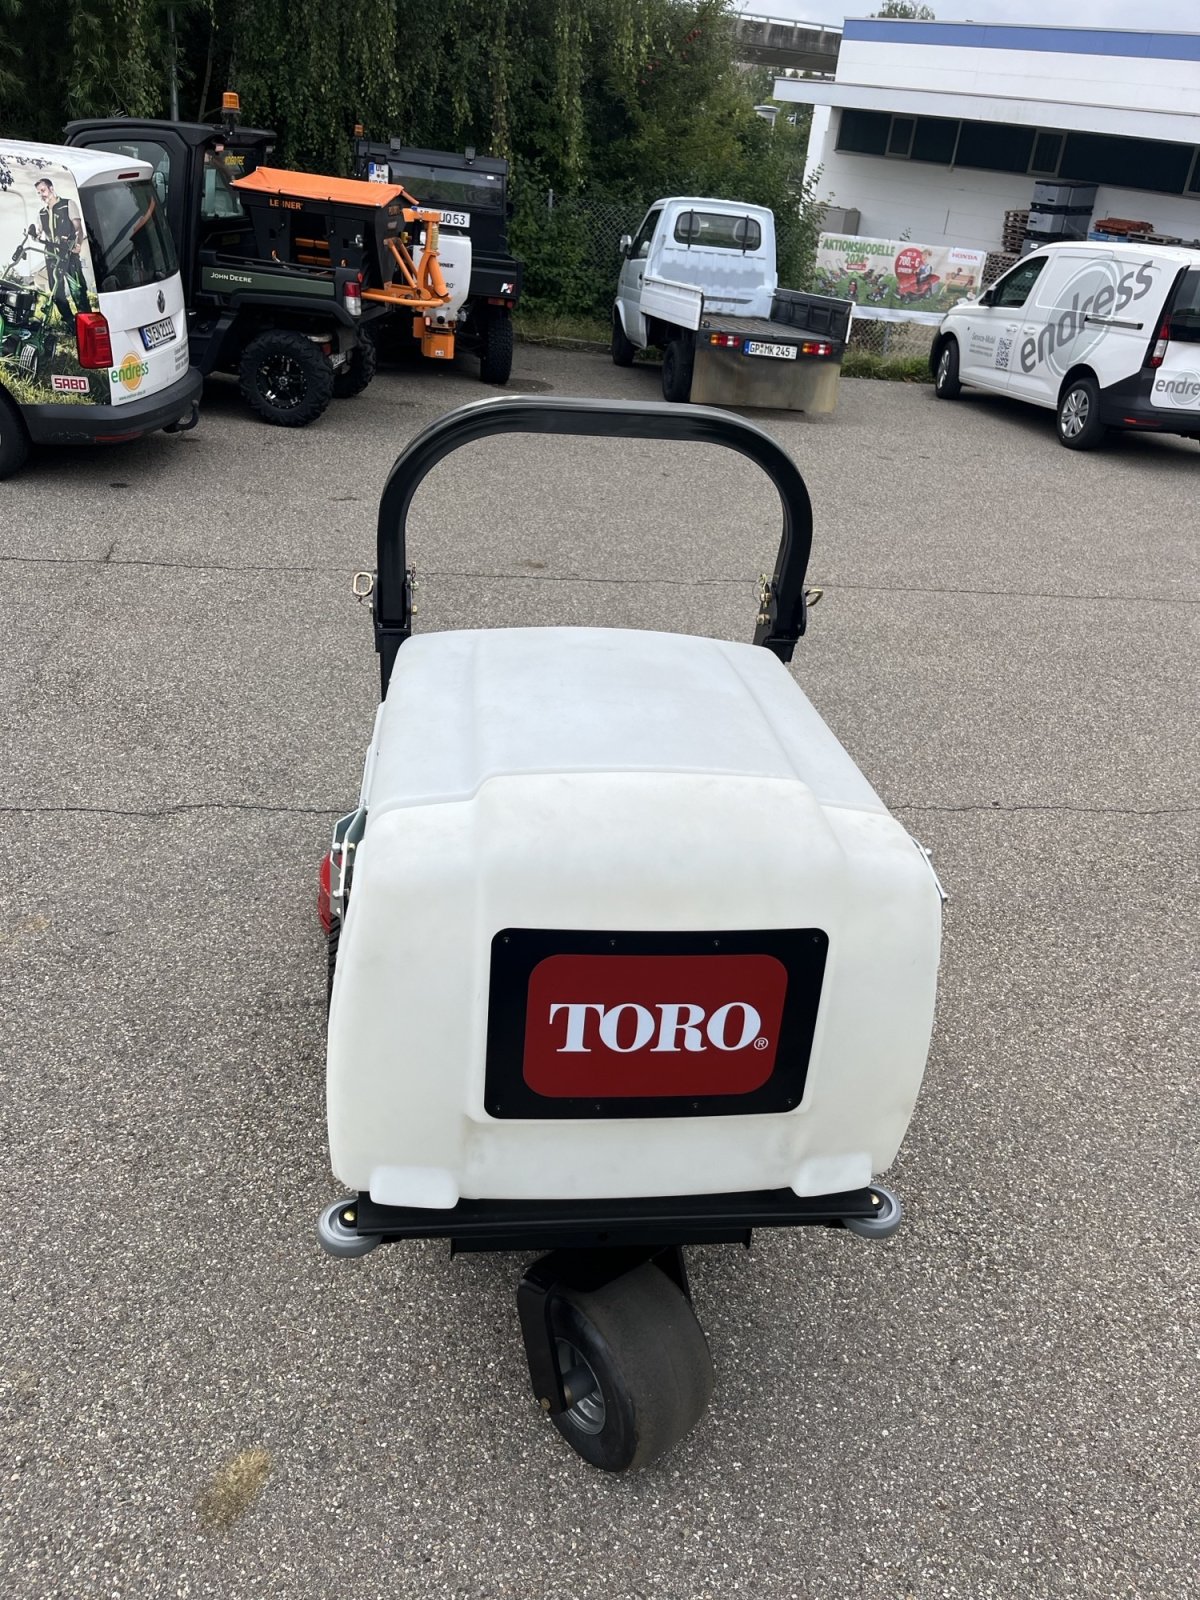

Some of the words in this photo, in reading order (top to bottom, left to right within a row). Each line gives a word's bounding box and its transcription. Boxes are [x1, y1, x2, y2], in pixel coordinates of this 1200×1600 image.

[453, 213, 466, 225] 53
[823, 238, 896, 257] AKTIONSMODELLE
[952, 252, 978, 261] HONDA
[210, 272, 229, 280] JOHN
[229, 274, 252, 283] DEERE
[1020, 260, 1154, 373] endress
[750, 343, 760, 353] GP
[776, 346, 791, 357] 245
[111, 361, 149, 383] endress
[54, 378, 87, 390] SABO
[549, 1002, 762, 1052] TORO
